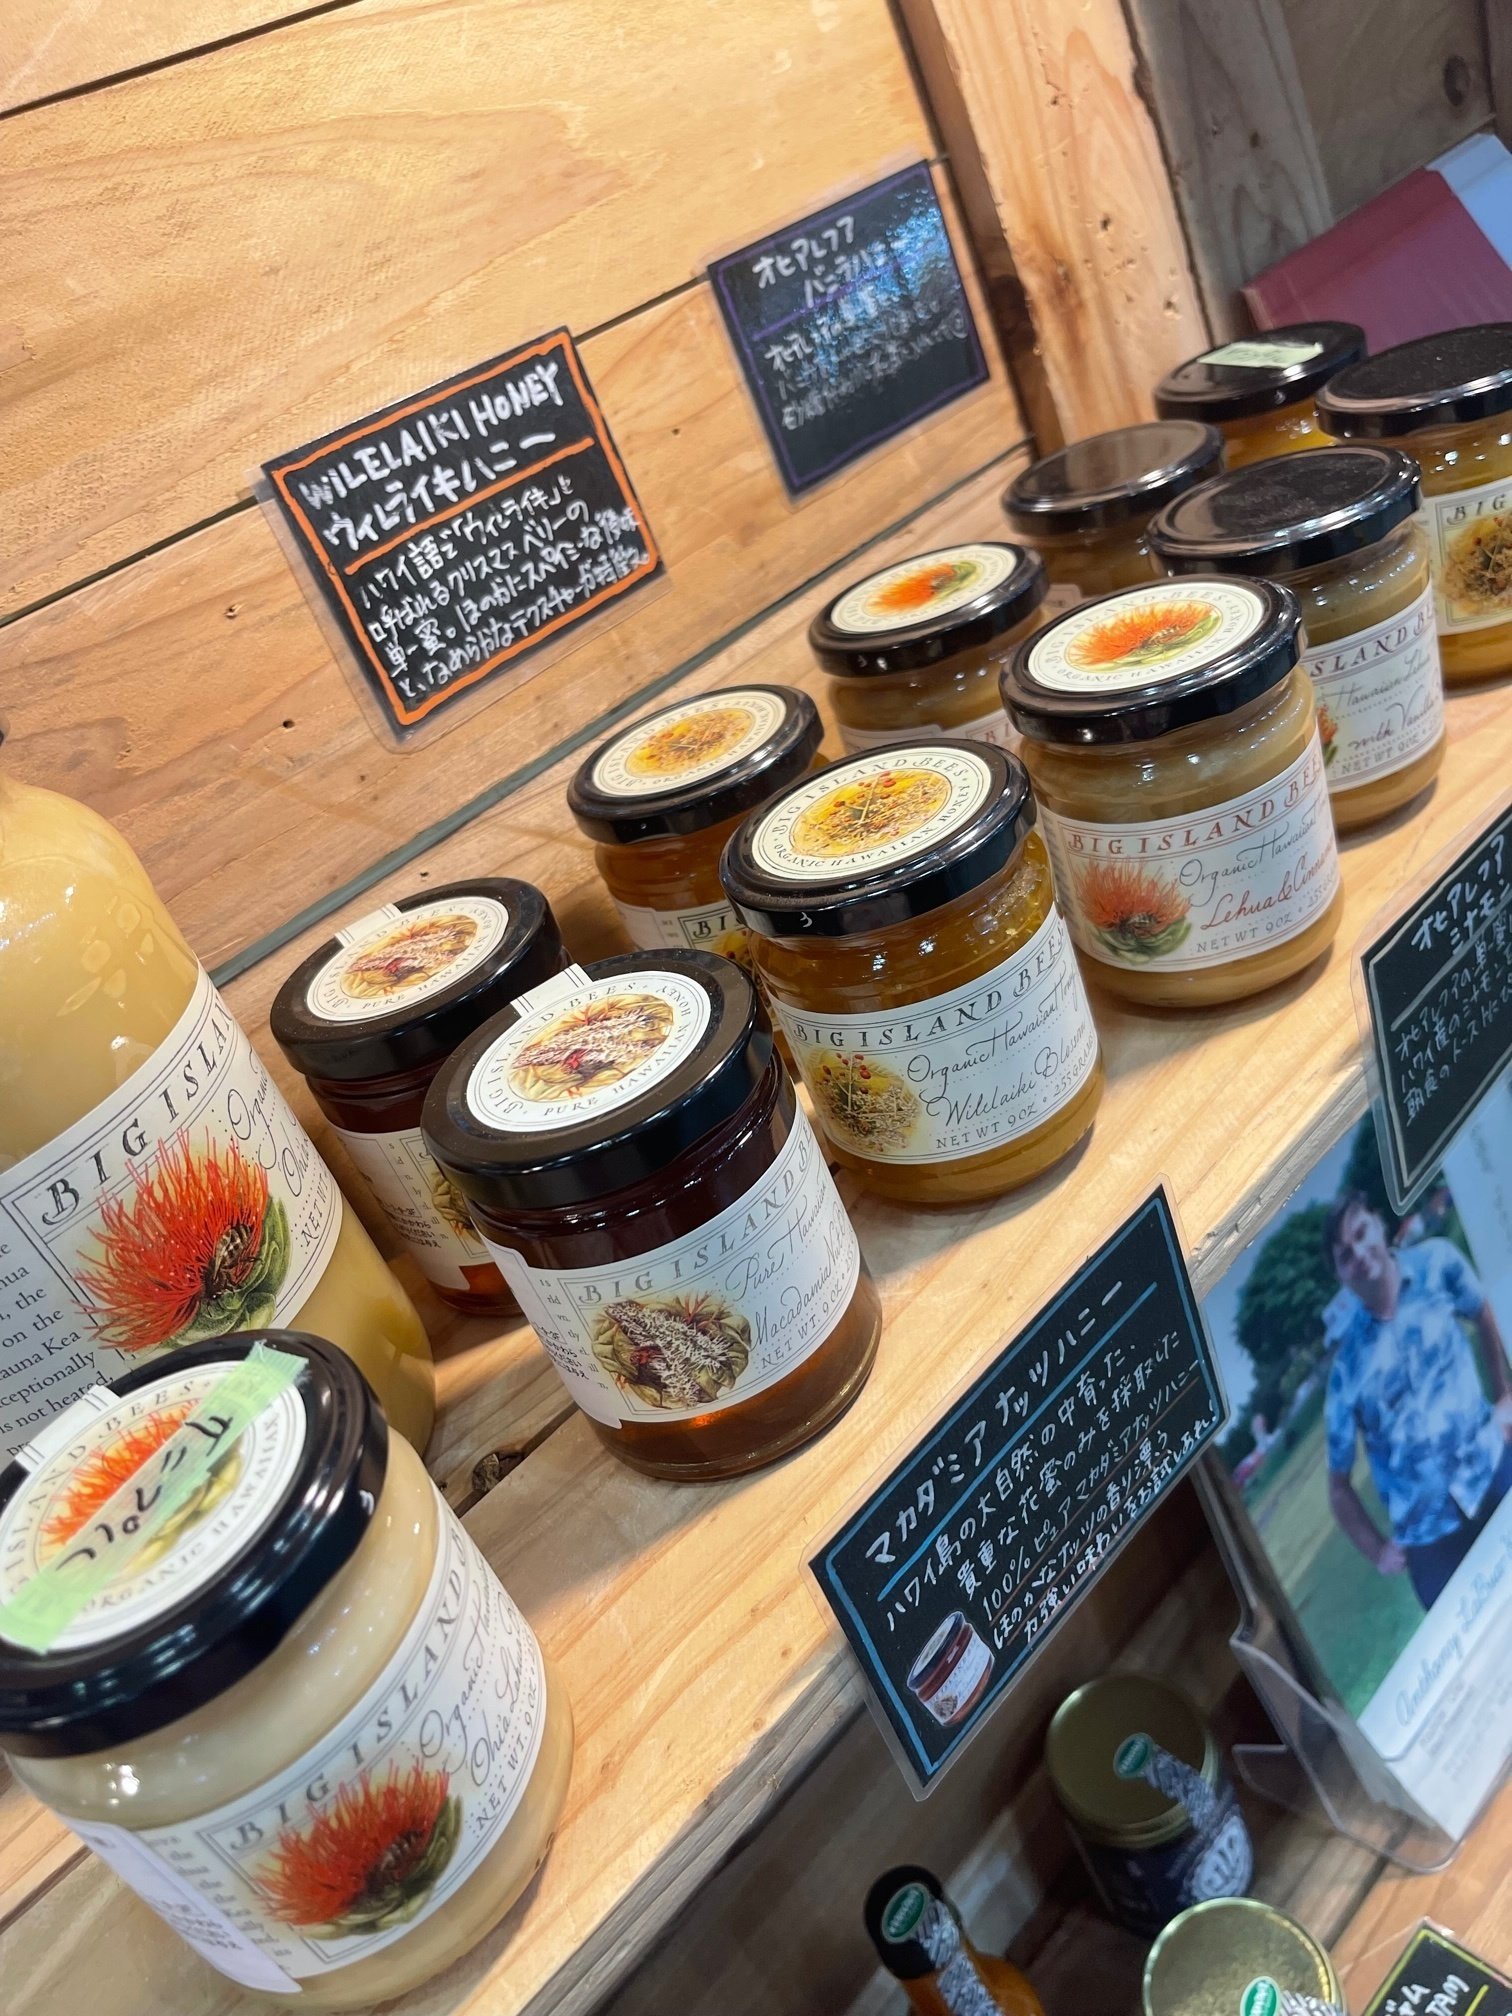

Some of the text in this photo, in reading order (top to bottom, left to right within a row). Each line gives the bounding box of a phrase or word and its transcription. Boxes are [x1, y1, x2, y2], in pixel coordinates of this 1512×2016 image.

[299, 361, 565, 510] WILELAIKI HONEY
[1446, 494, 1507, 525] BIG
[771, 755, 969, 836] BIG ISLAND BEES
[774, 784, 972, 868] ORGANIC HAWAIIAN HONEY
[1067, 832, 1123, 855] BIG
[1138, 798, 1275, 854] ISLAND
[1178, 857, 1257, 908] Organic
[1199, 889, 1276, 930] Lehua
[396, 905, 457, 928] BEES
[1197, 935, 1229, 954] NET
[1235, 926, 1258, 943] WT
[362, 994, 405, 1010] PURE
[793, 922, 1067, 1048] BIG ISLAND BEES
[487, 980, 637, 1115] BIG ISLAND BEES
[543, 983, 694, 1116] PURE HAWAIIAN HONEY
[906, 1050, 990, 1098] Organic
[967, 1002, 1057, 1057] Hawaiian
[936, 1132, 970, 1150] NET
[975, 1121, 1001, 1143] WT
[41, 1118, 148, 1227] BIG
[301, 1199, 323, 1248] NET
[578, 1272, 654, 1304] BIG
[670, 1170, 796, 1280] ISLAND
[15, 1288, 48, 1311] the
[724, 1251, 785, 1303] Pure
[2, 1310, 65, 1349] on the
[747, 1266, 830, 1352] Macadamia
[41, 1331, 82, 1356] Kea
[761, 1340, 792, 1370] NET
[15, 1406, 48, 1428] not
[99, 1381, 196, 1440] BEES
[230, 1566, 468, 1852] BIG ISLAND
[476, 1775, 508, 1832] NET
